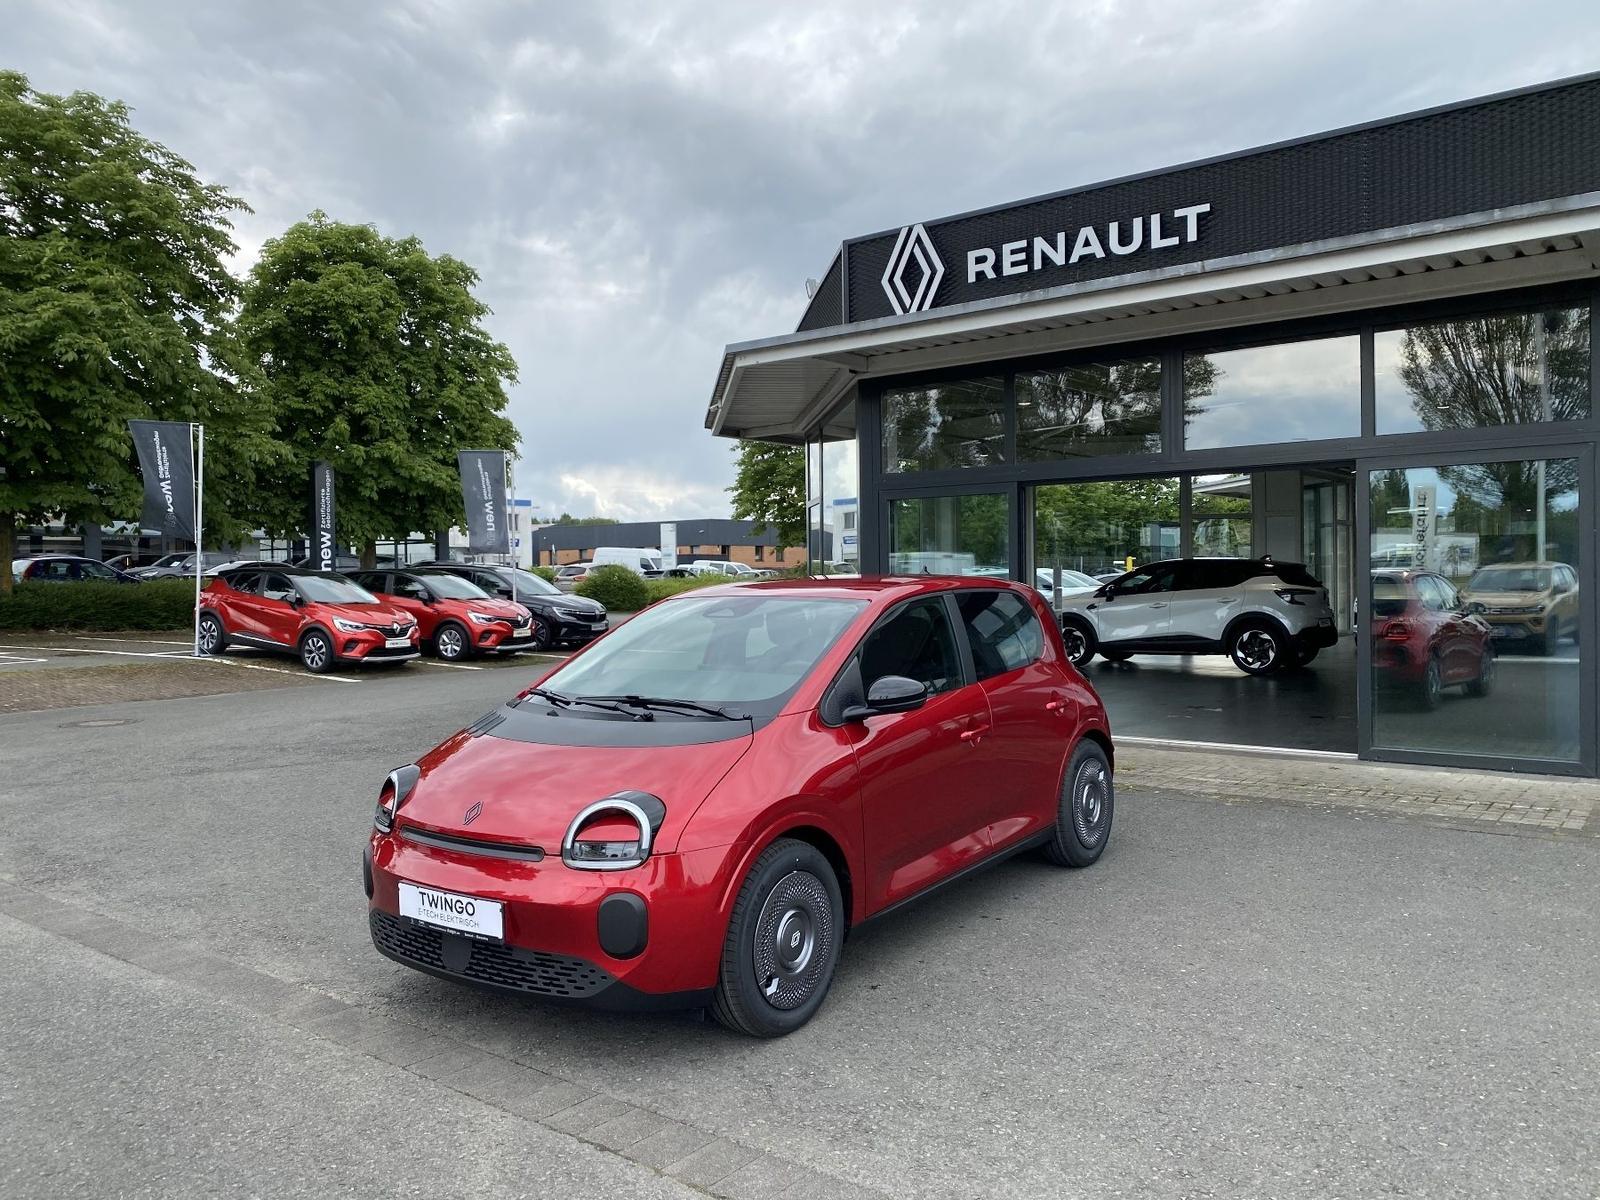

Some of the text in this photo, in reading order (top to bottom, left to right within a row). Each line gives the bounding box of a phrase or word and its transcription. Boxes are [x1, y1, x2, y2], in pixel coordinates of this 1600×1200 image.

[966, 203, 1211, 284] RENAULT
[320, 532, 332, 572] new
[418, 891, 476, 917] TWINGO
[418, 907, 439, 919] E-TECH
[439, 913, 480, 928] ELEKTRISCH
